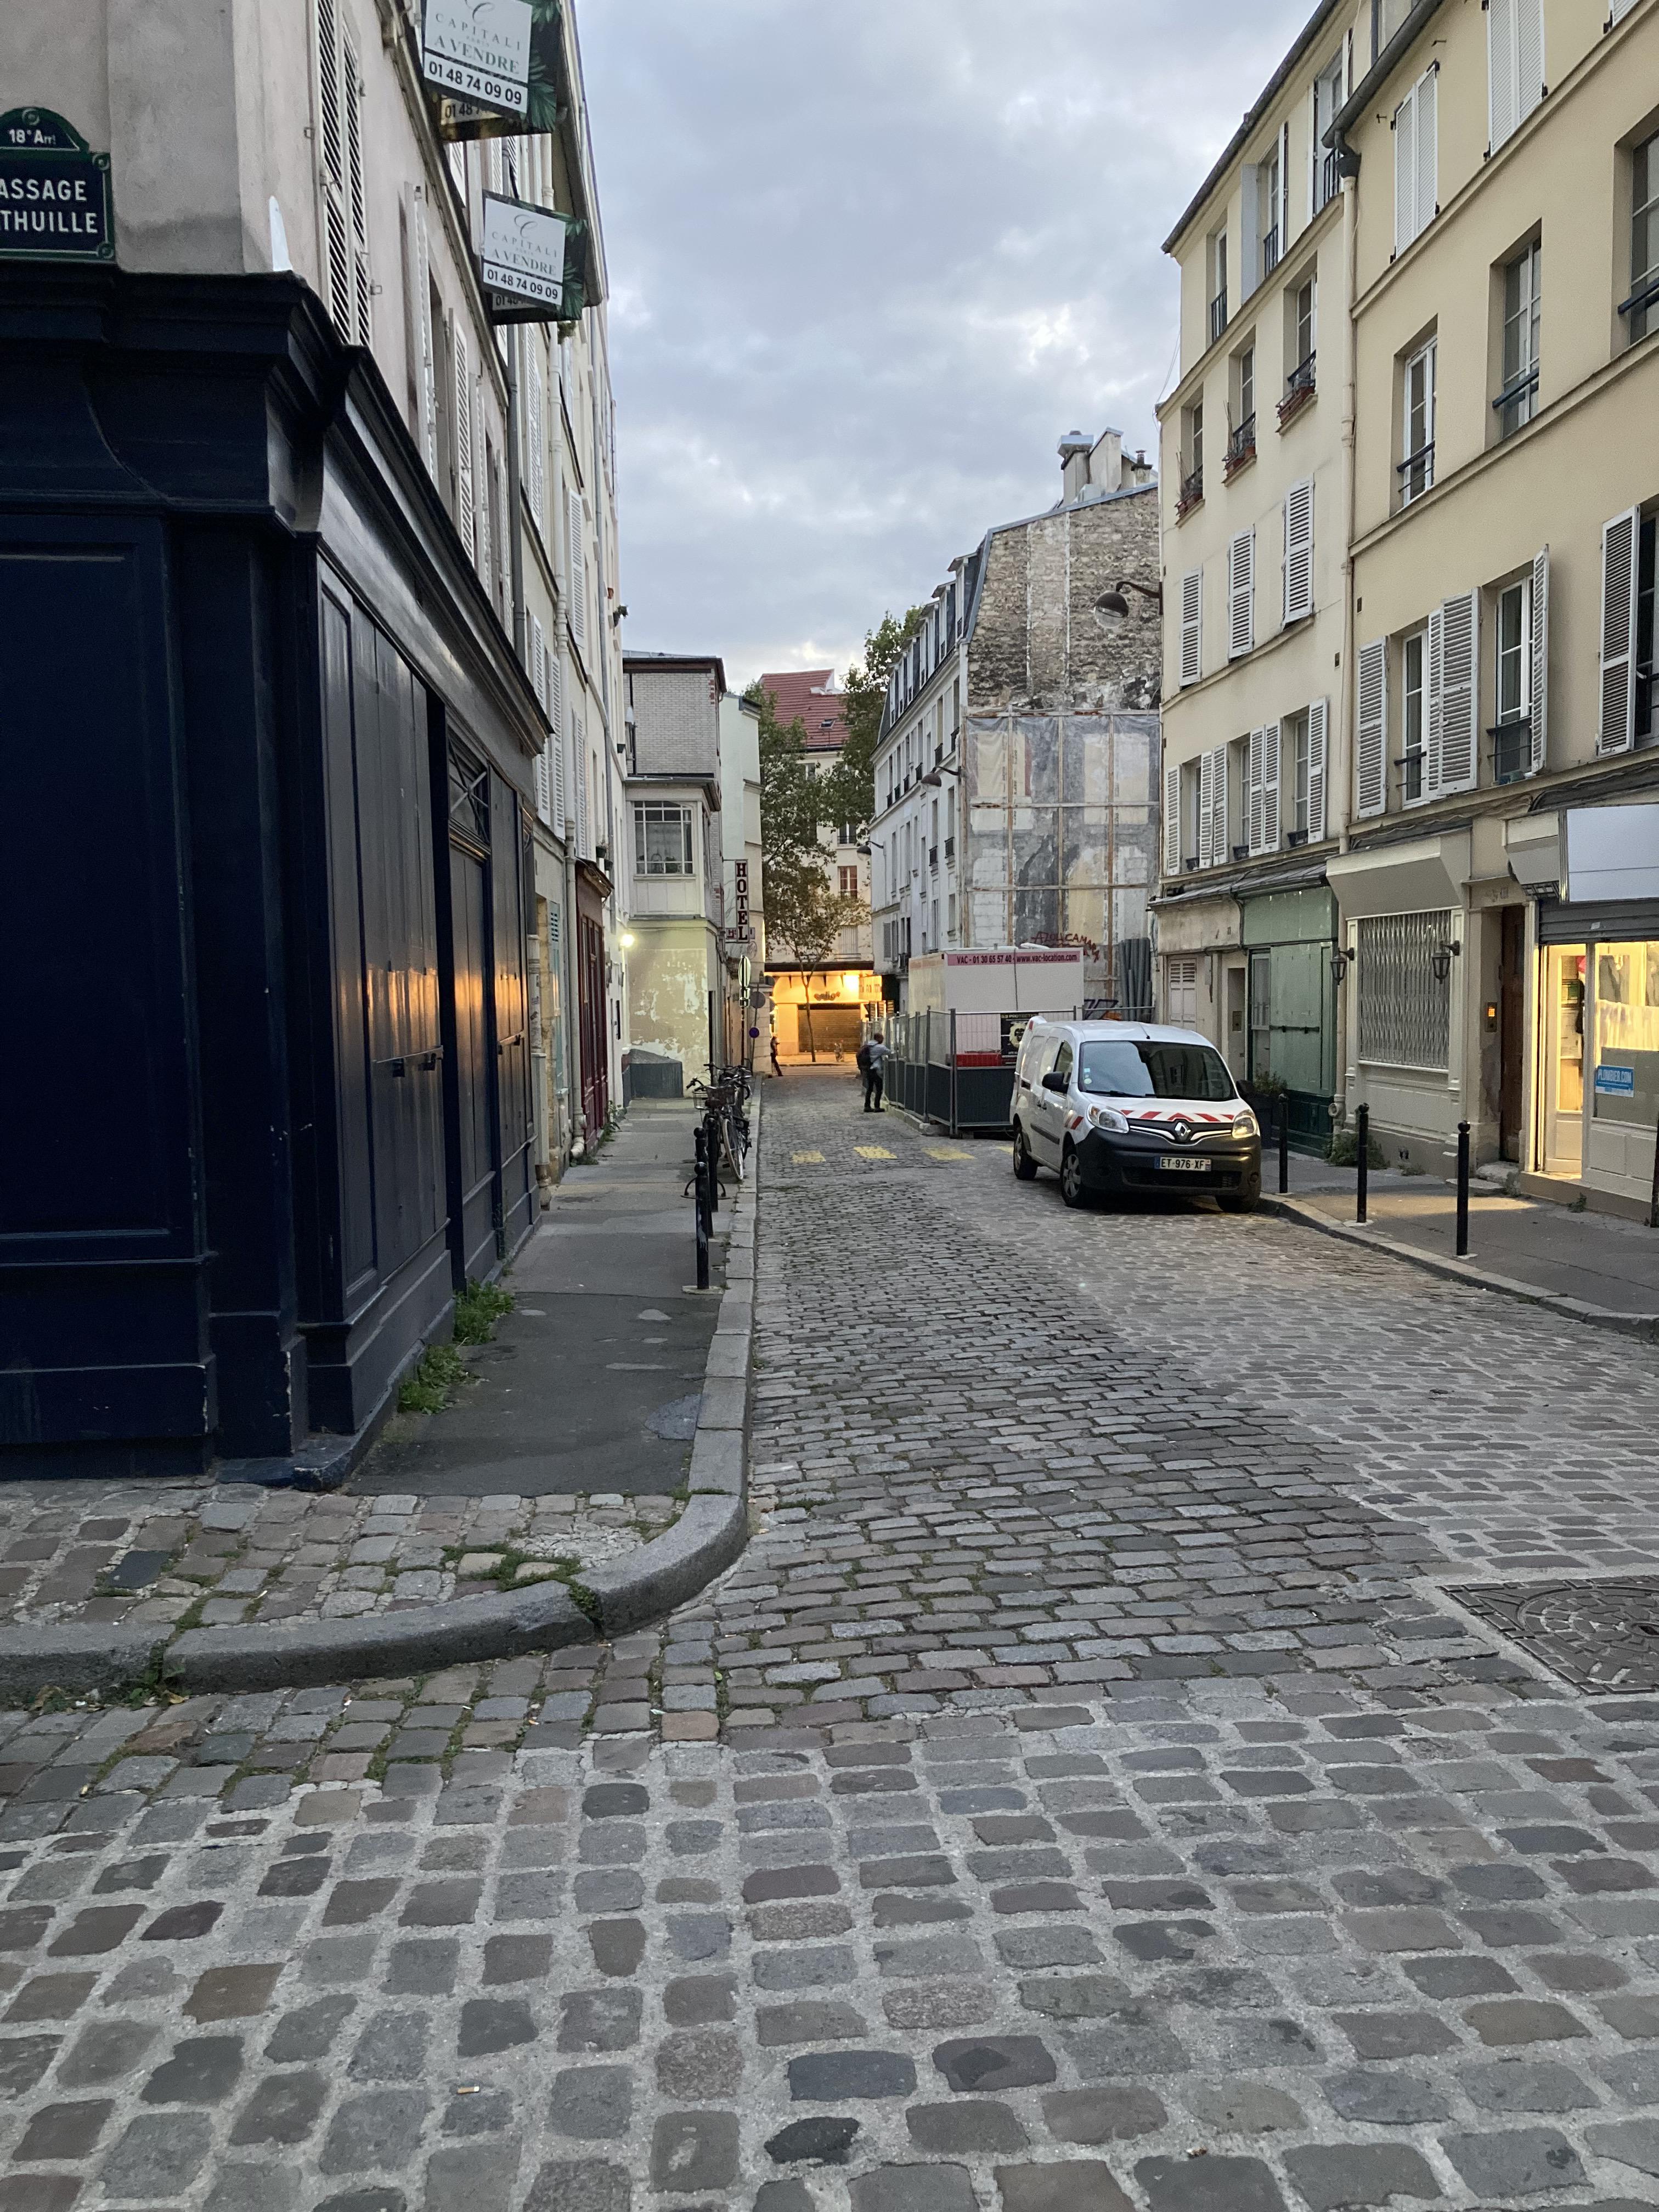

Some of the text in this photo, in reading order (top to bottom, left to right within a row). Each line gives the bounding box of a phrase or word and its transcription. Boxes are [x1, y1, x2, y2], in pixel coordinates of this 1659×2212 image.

[436, 13, 520, 51] CAPITALI
[429, 61, 522, 105] 01 48 74 09 09
[445, 103, 456, 118] 01
[487, 269, 558, 300] 01 48 74 09 09
[737, 863, 747, 940] HOTEL
[957, 956, 968, 964] VAC
[973, 955, 979, 964] 01
[981, 955, 988, 963] 30
[989, 955, 996, 963] 65
[997, 955, 1004, 963] 57
[1005, 955, 1012, 963] 40
